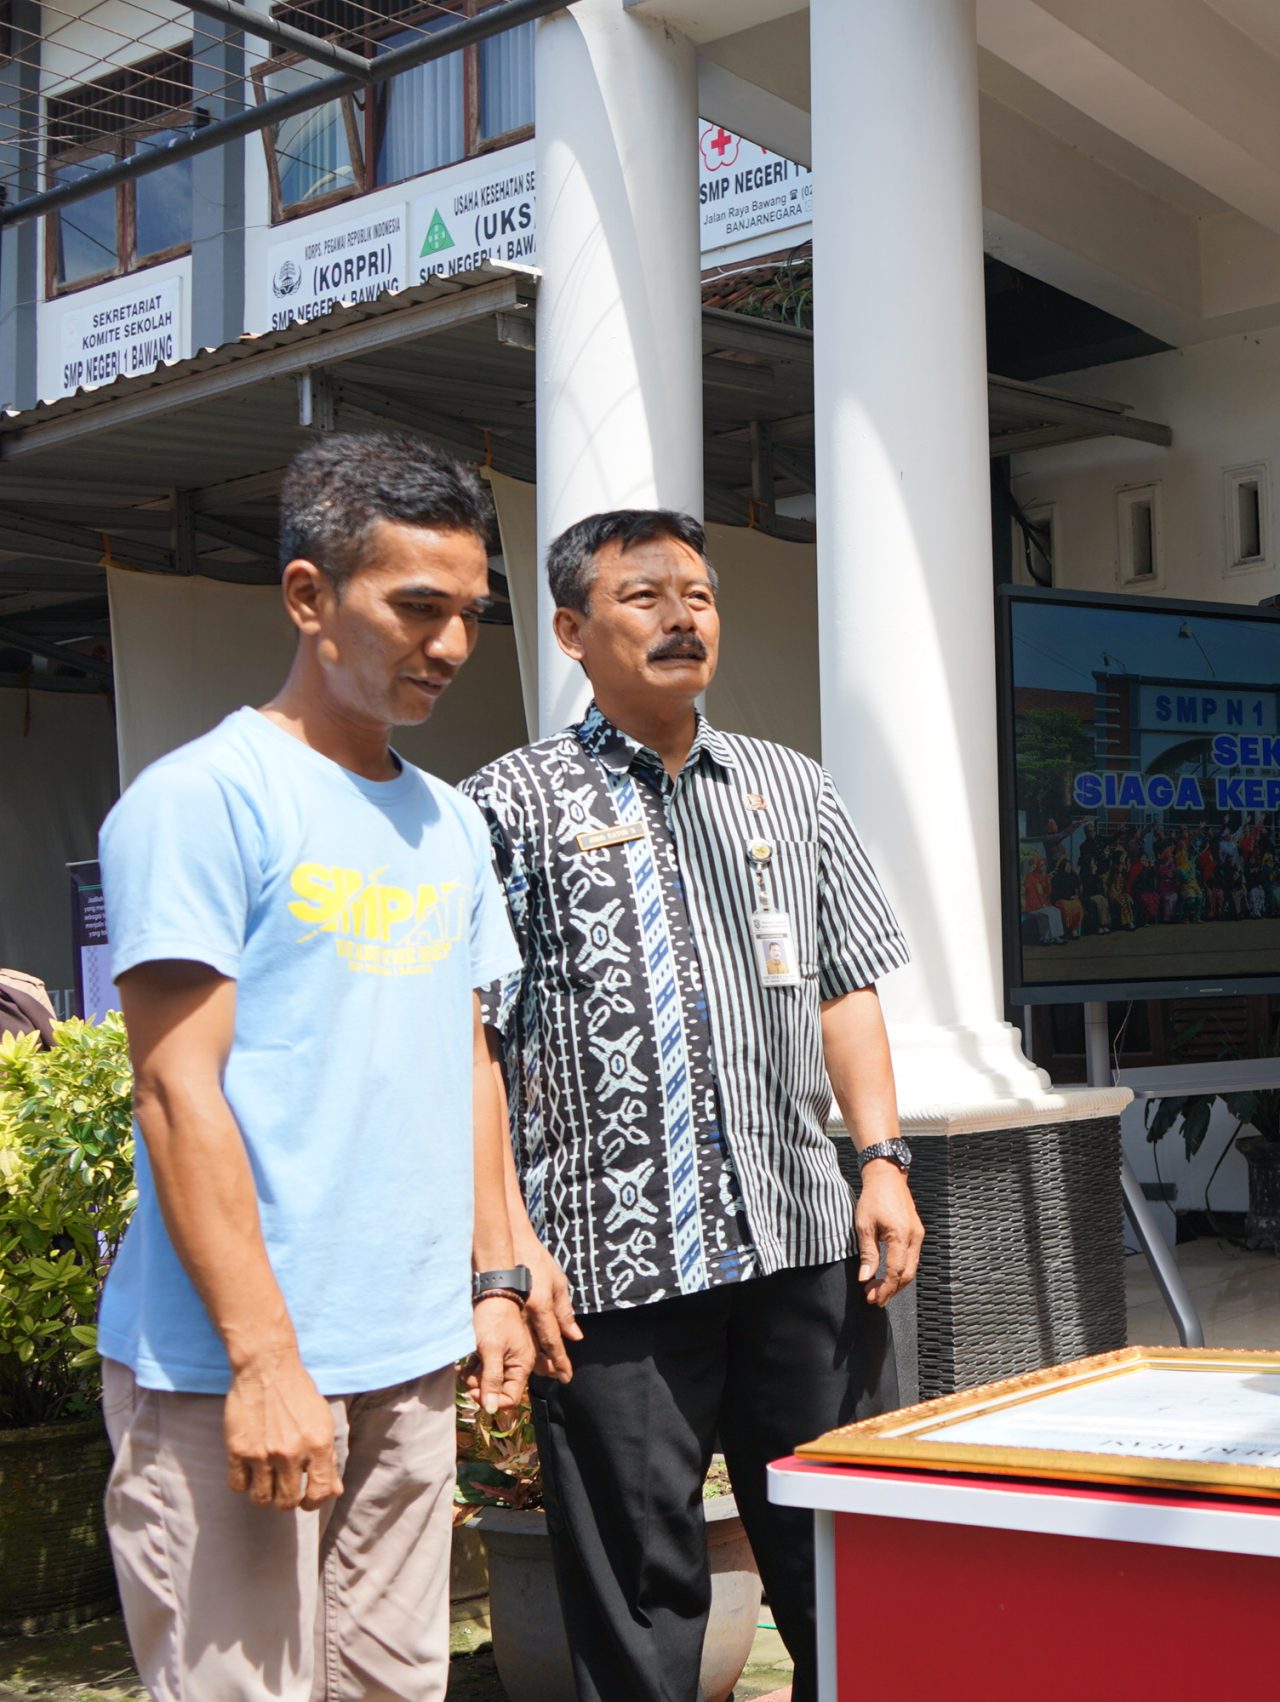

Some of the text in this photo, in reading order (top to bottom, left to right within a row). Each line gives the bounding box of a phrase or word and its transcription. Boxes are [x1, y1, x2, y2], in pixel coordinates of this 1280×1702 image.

[454, 189, 480, 216] USAHA
[480, 175, 524, 207] KESEHATAN
[700, 177, 730, 205] SMP
[735, 160, 788, 195] NEGERI
[703, 211, 727, 226] Jalan
[728, 201, 750, 219] Raya
[752, 194, 787, 212] Bawang
[726, 203, 803, 234] BANJARNEGARA
[324, 231, 346, 256] PEGAWAI
[347, 224, 372, 249] REPUBLIK
[372, 217, 400, 240] INDONESIA
[507, 234, 536, 261] BAW
[313, 242, 392, 296] (KORPRI)
[82, 311, 172, 350] KOMITE SEKOLAH
[92, 295, 162, 328] SEKRETARIAT
[63, 334, 173, 389] SMP NEGERI 1 BAWANG
[1155, 696, 1217, 725] SMP
[1226, 699, 1244, 727] N
[1251, 700, 1264, 727] 1
[1075, 773, 1204, 810] SIAGA
